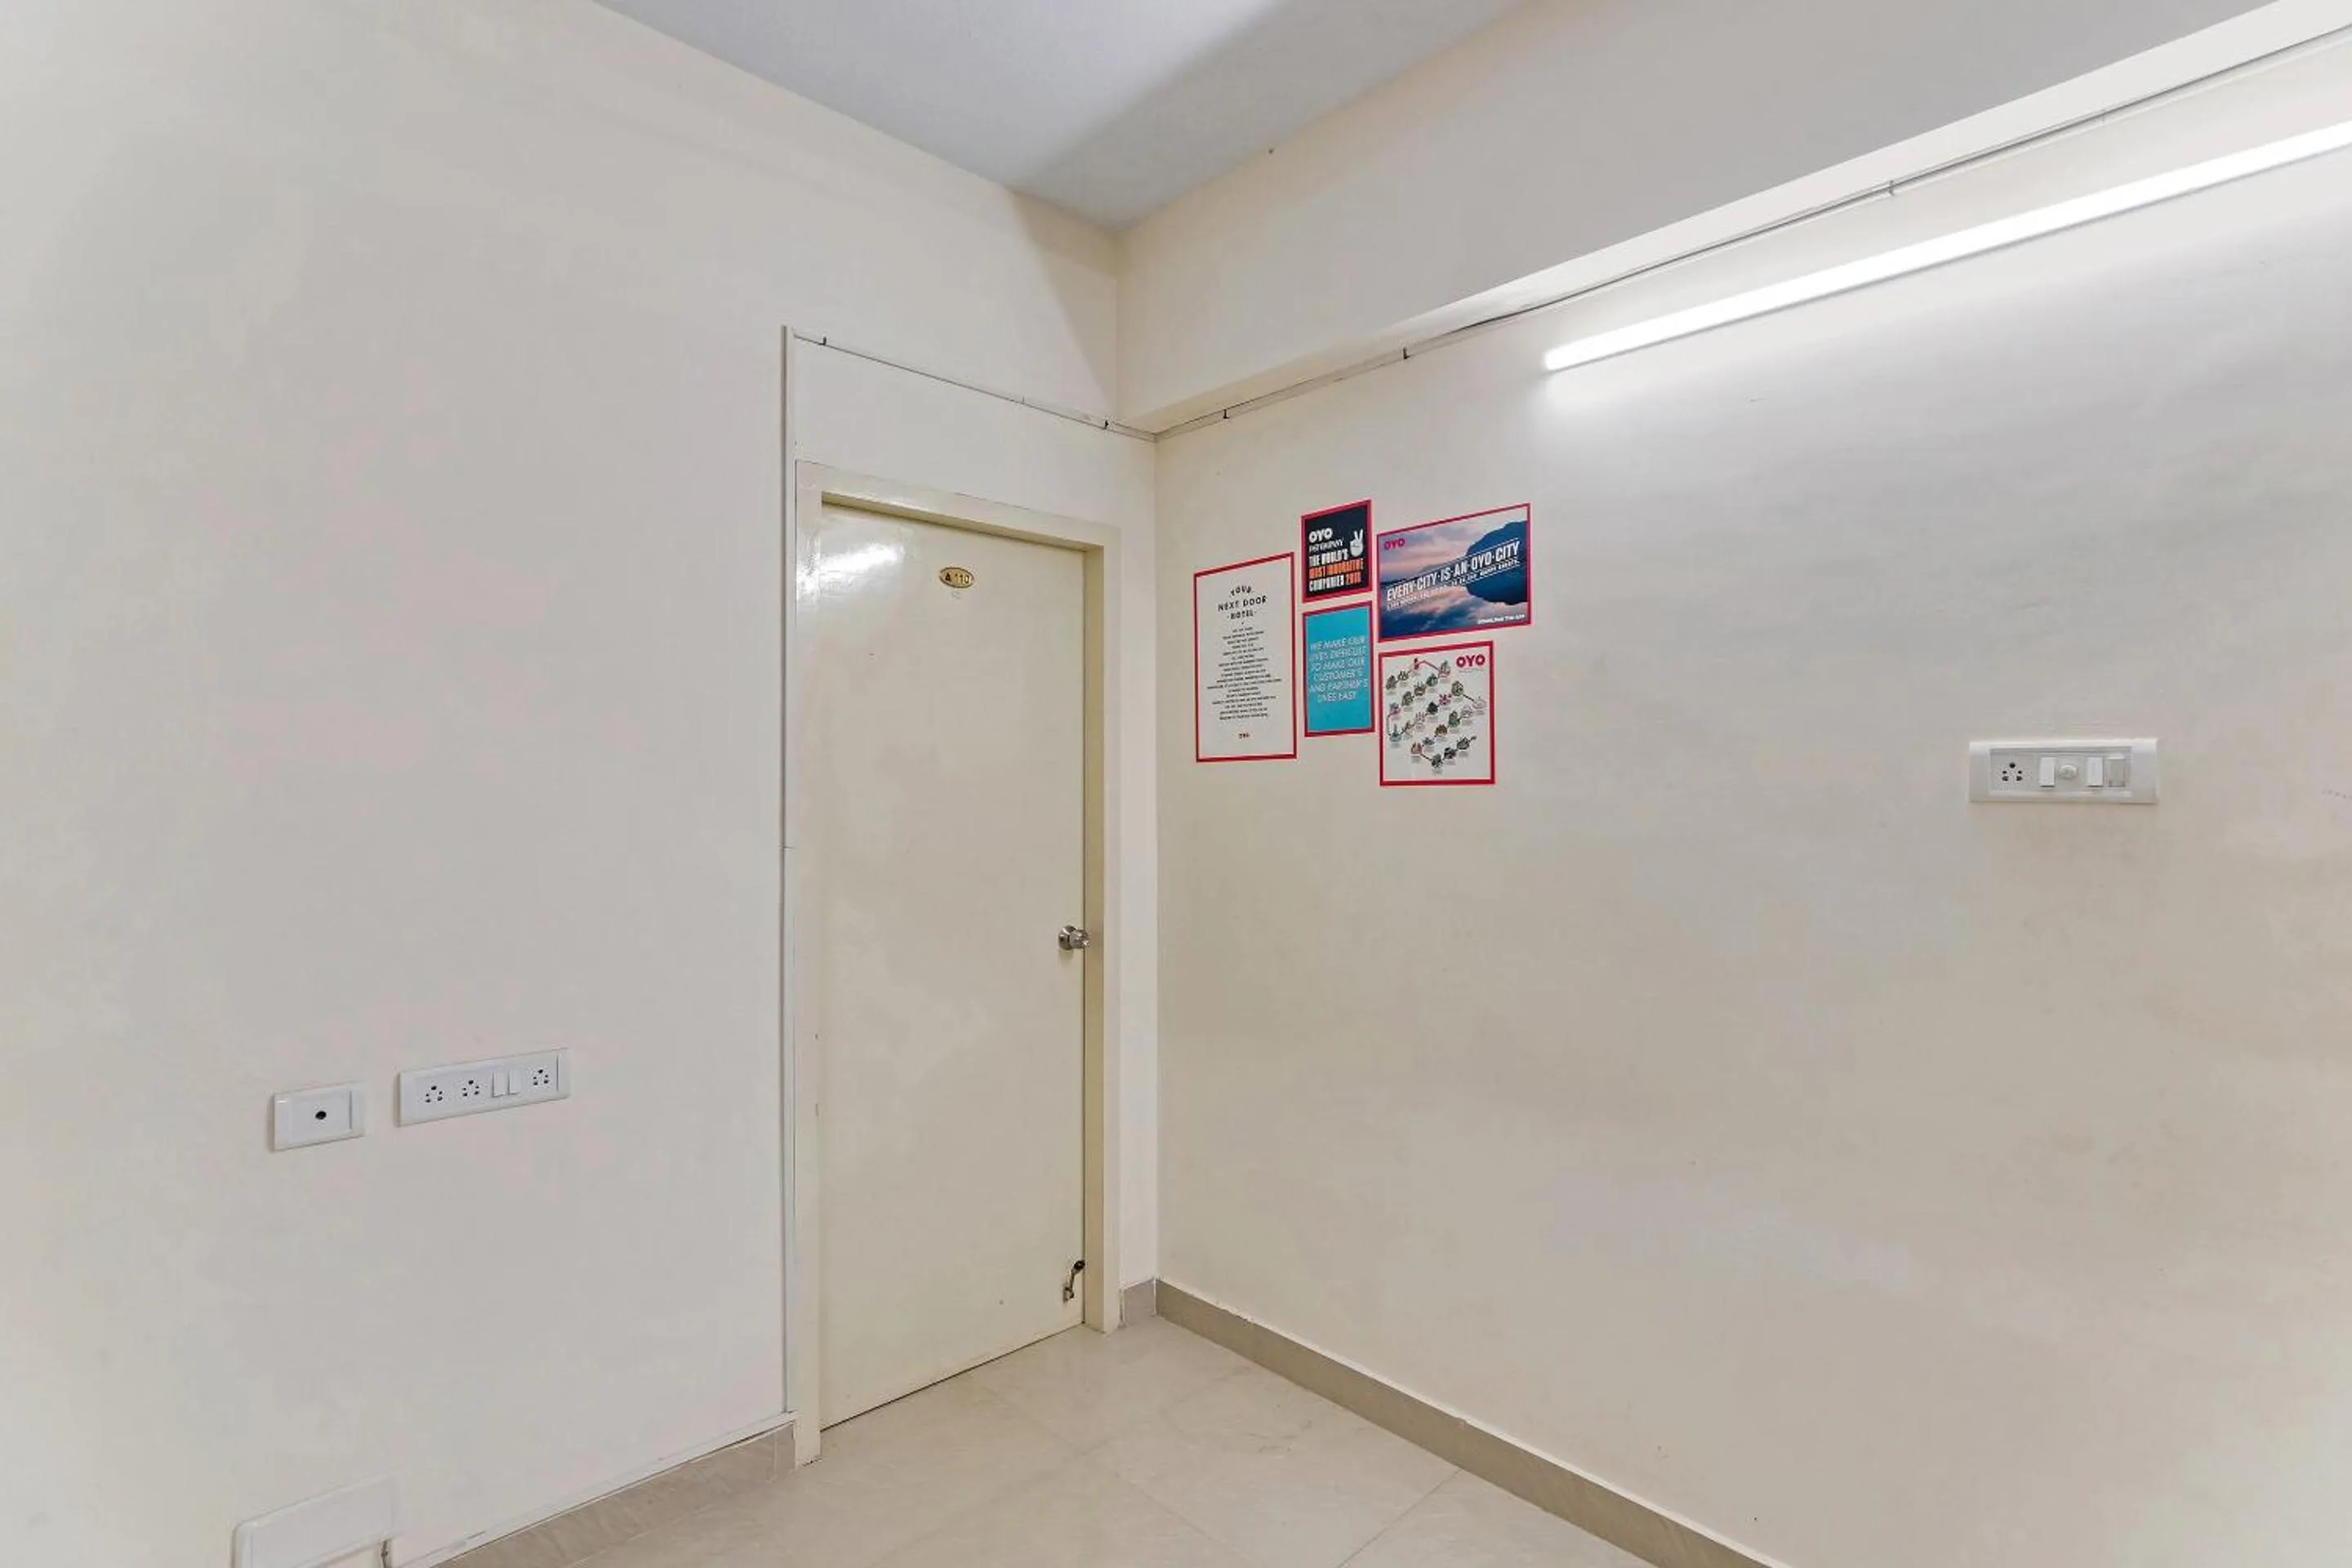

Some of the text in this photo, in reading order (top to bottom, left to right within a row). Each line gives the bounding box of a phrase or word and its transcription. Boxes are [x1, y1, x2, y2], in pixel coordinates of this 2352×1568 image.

[1309, 528, 1333, 543] OYO
[1384, 538, 1405, 550] OYO
[1387, 580, 1414, 601] EVERY
[1417, 572, 1438, 590] CITY
[1440, 567, 1452, 582] IS
[1454, 560, 1468, 577] AN
[1472, 551, 1492, 570] OYO
[1495, 541, 1521, 562] CITY
[1218, 595, 1267, 612] NEXT DOOR
[1456, 654, 1486, 667] OYO
